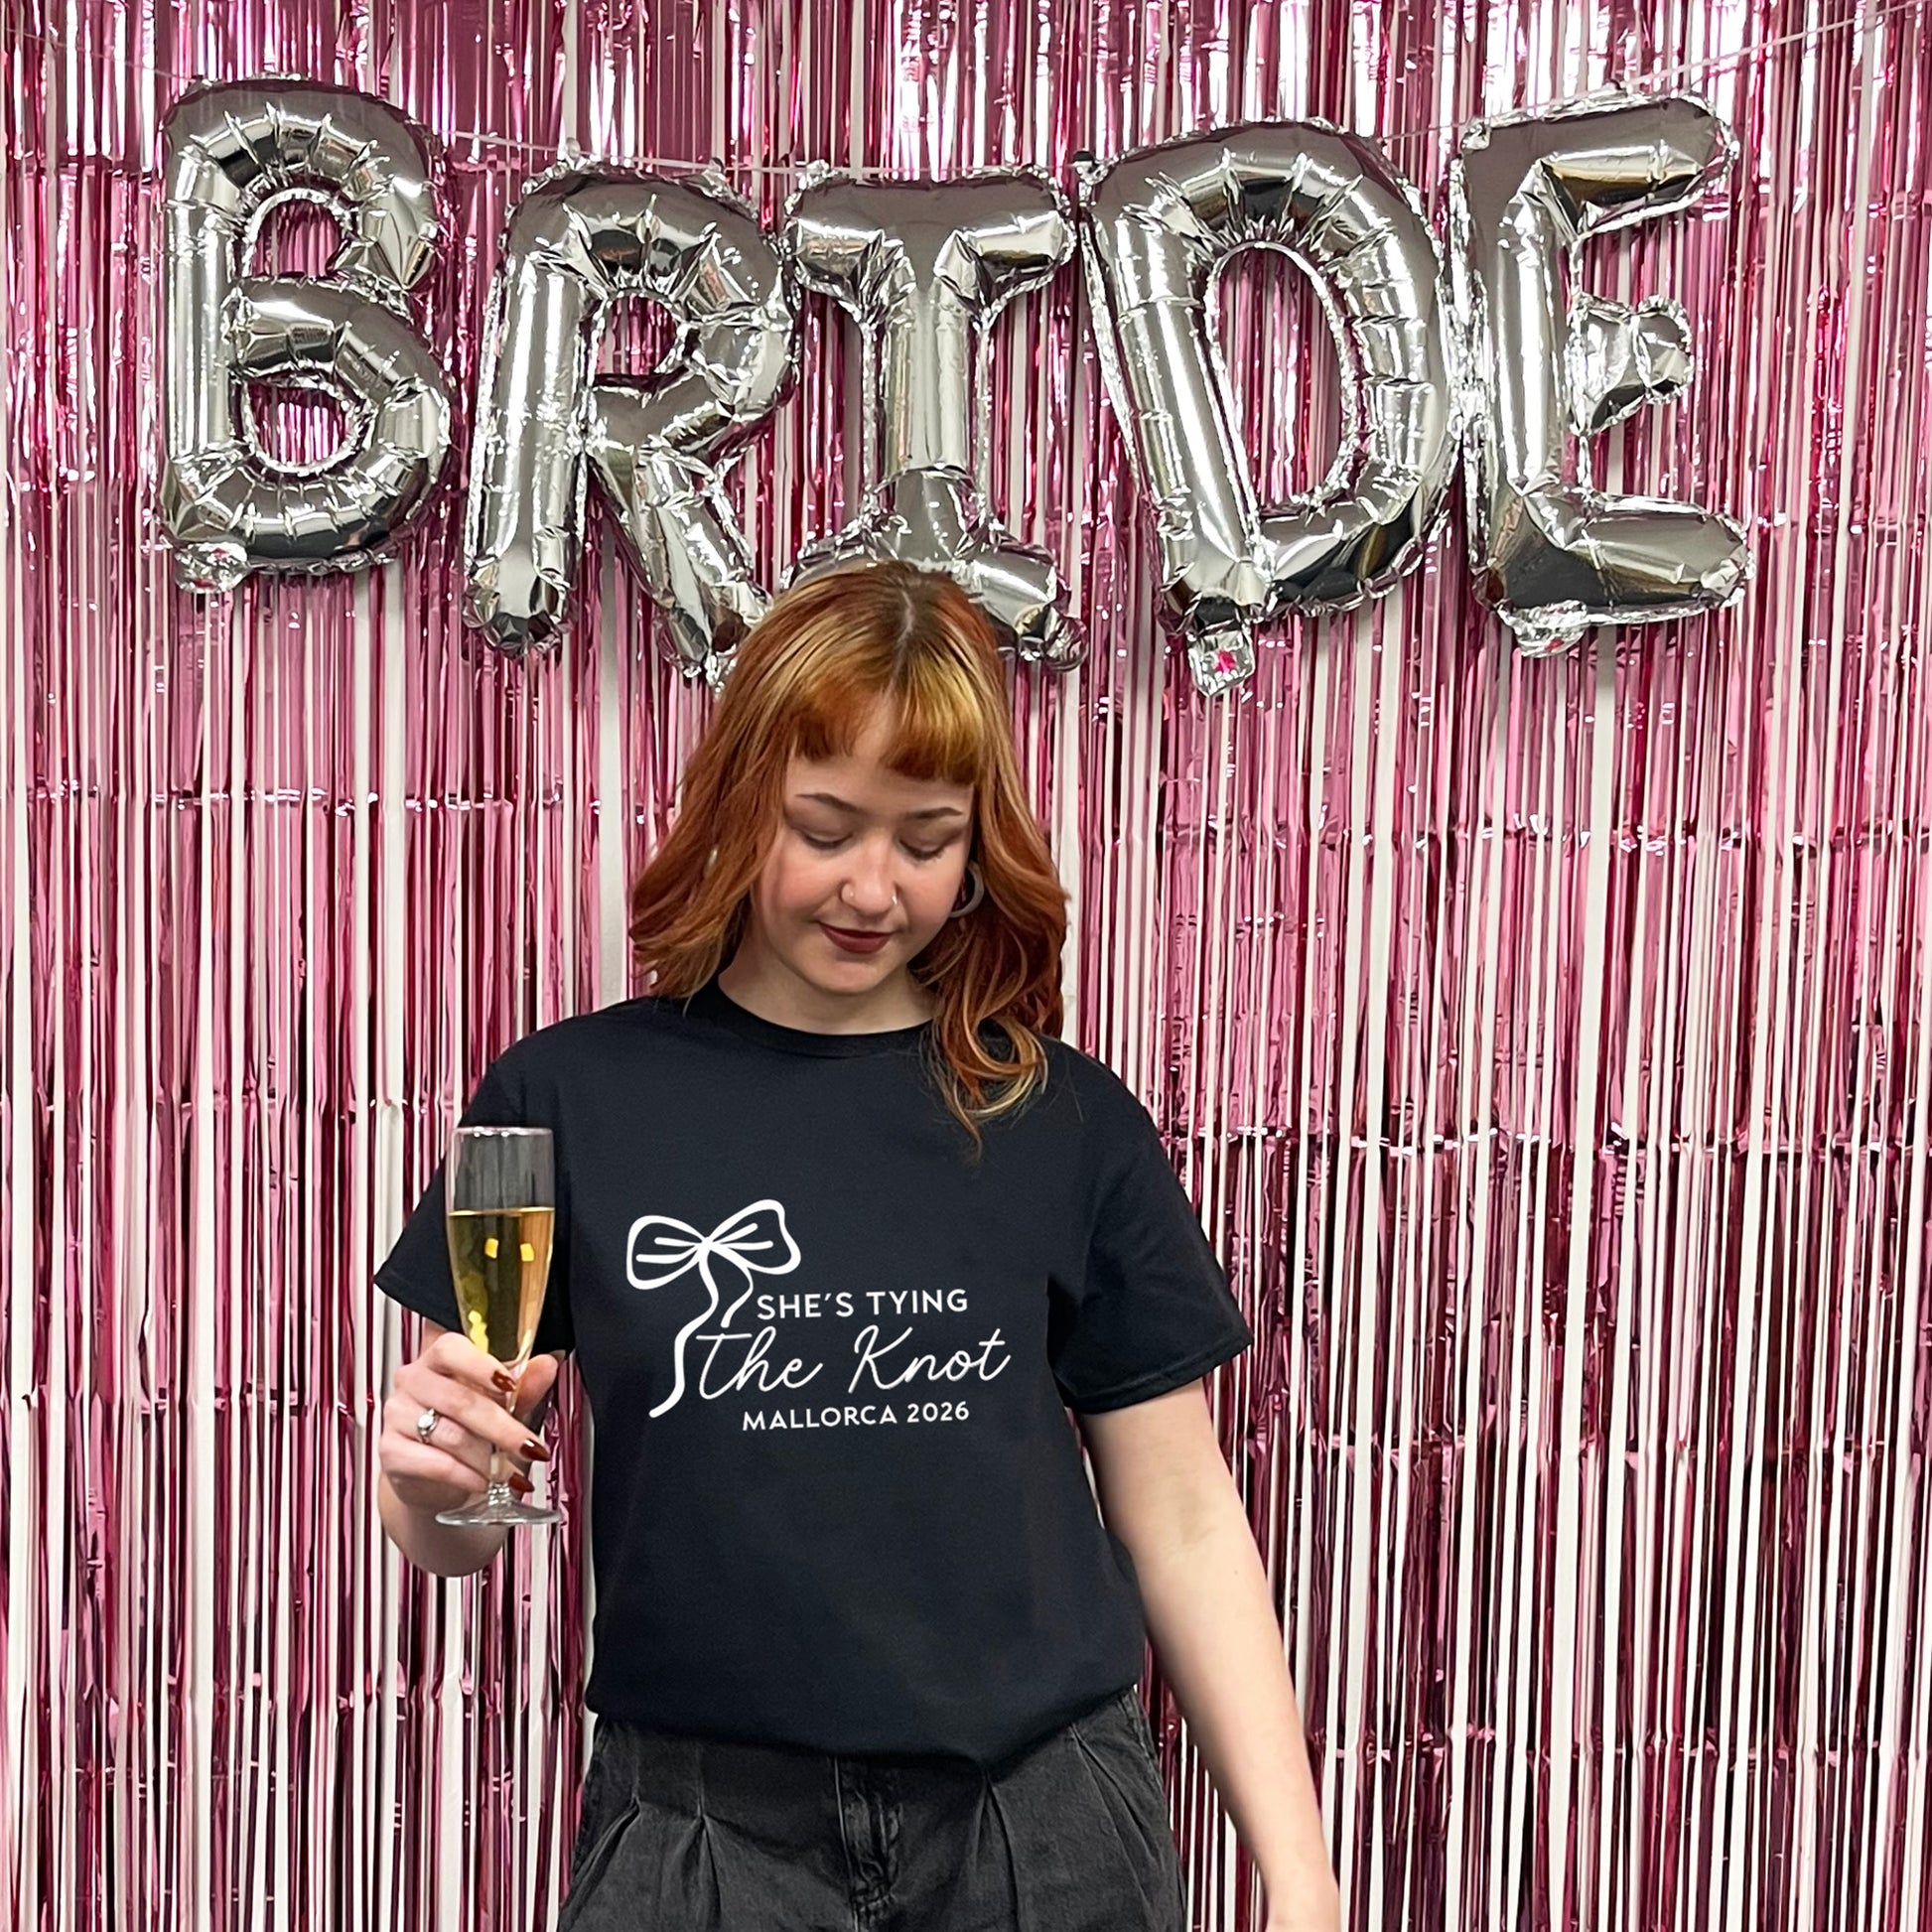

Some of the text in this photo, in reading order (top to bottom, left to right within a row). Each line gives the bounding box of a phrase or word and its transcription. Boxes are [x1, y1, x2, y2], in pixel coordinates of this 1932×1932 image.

[155, 73, 1756, 687] BRIDE
[757, 1289, 968, 1320] SHE'S TYING
[695, 1323, 1012, 1400] the Knot
[742, 1400, 970, 1432] MALLORCA 2026
